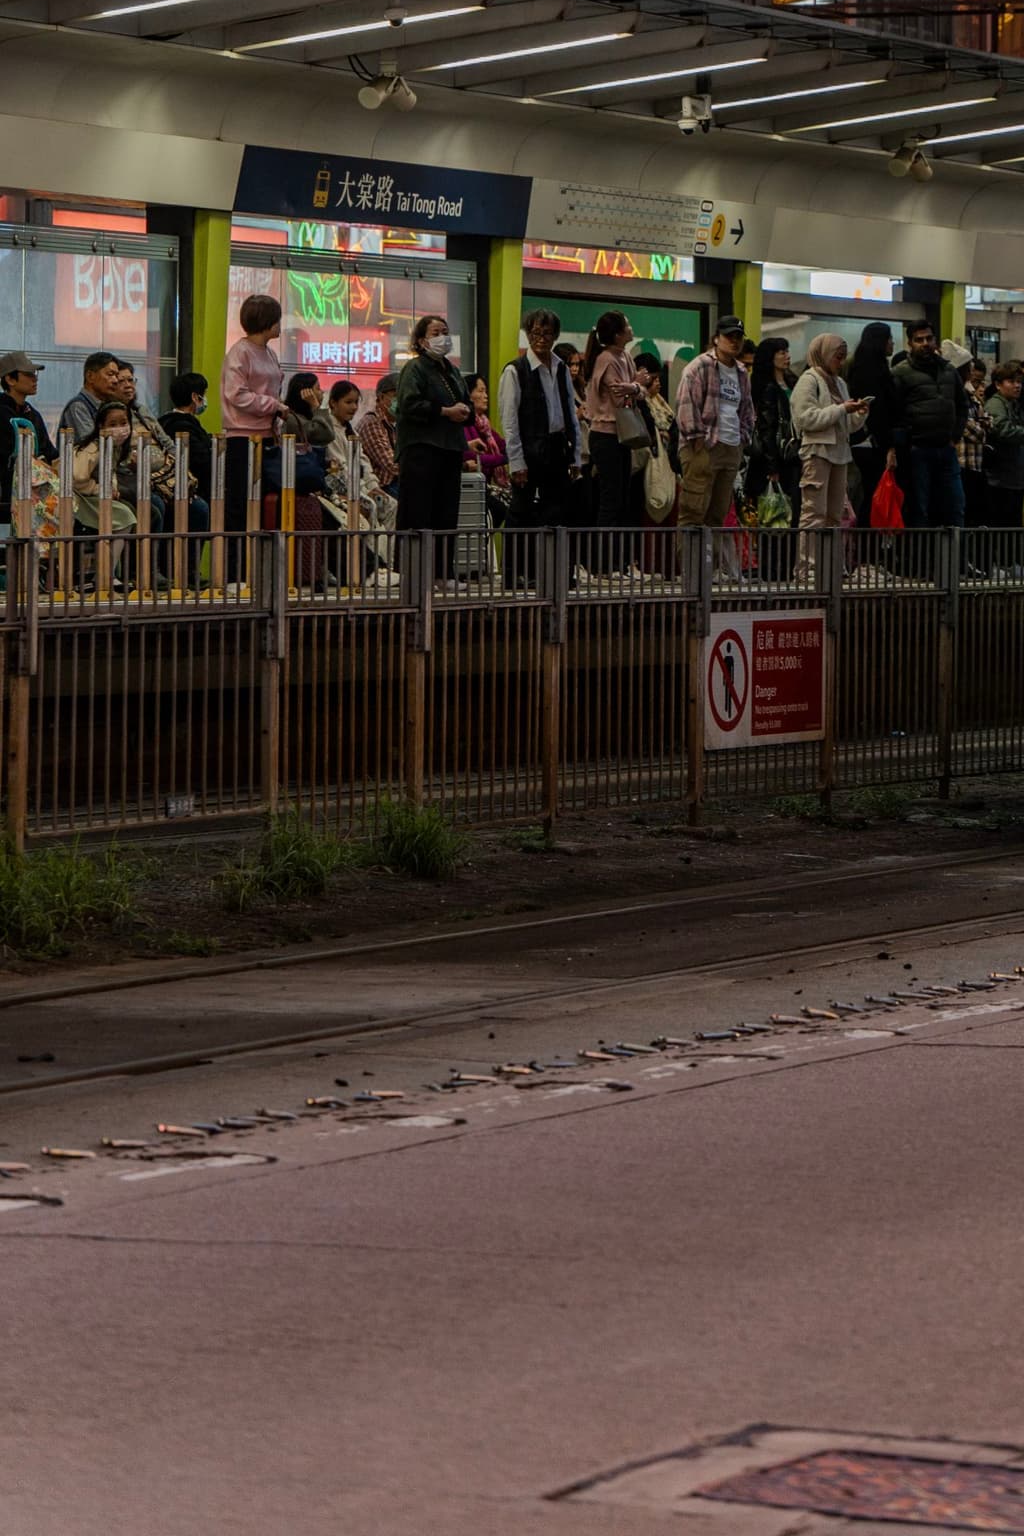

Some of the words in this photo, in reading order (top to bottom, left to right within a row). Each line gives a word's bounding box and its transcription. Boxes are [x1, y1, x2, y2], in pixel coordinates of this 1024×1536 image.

[336, 171, 395, 213] 大棠路
[397, 192, 410, 212] Tai
[412, 193, 436, 220] Tong
[437, 196, 463, 218] Road
[302, 340, 383, 364] 限時折扣
[756, 629, 774, 650] 危險
[755, 685, 777, 700] Danger
